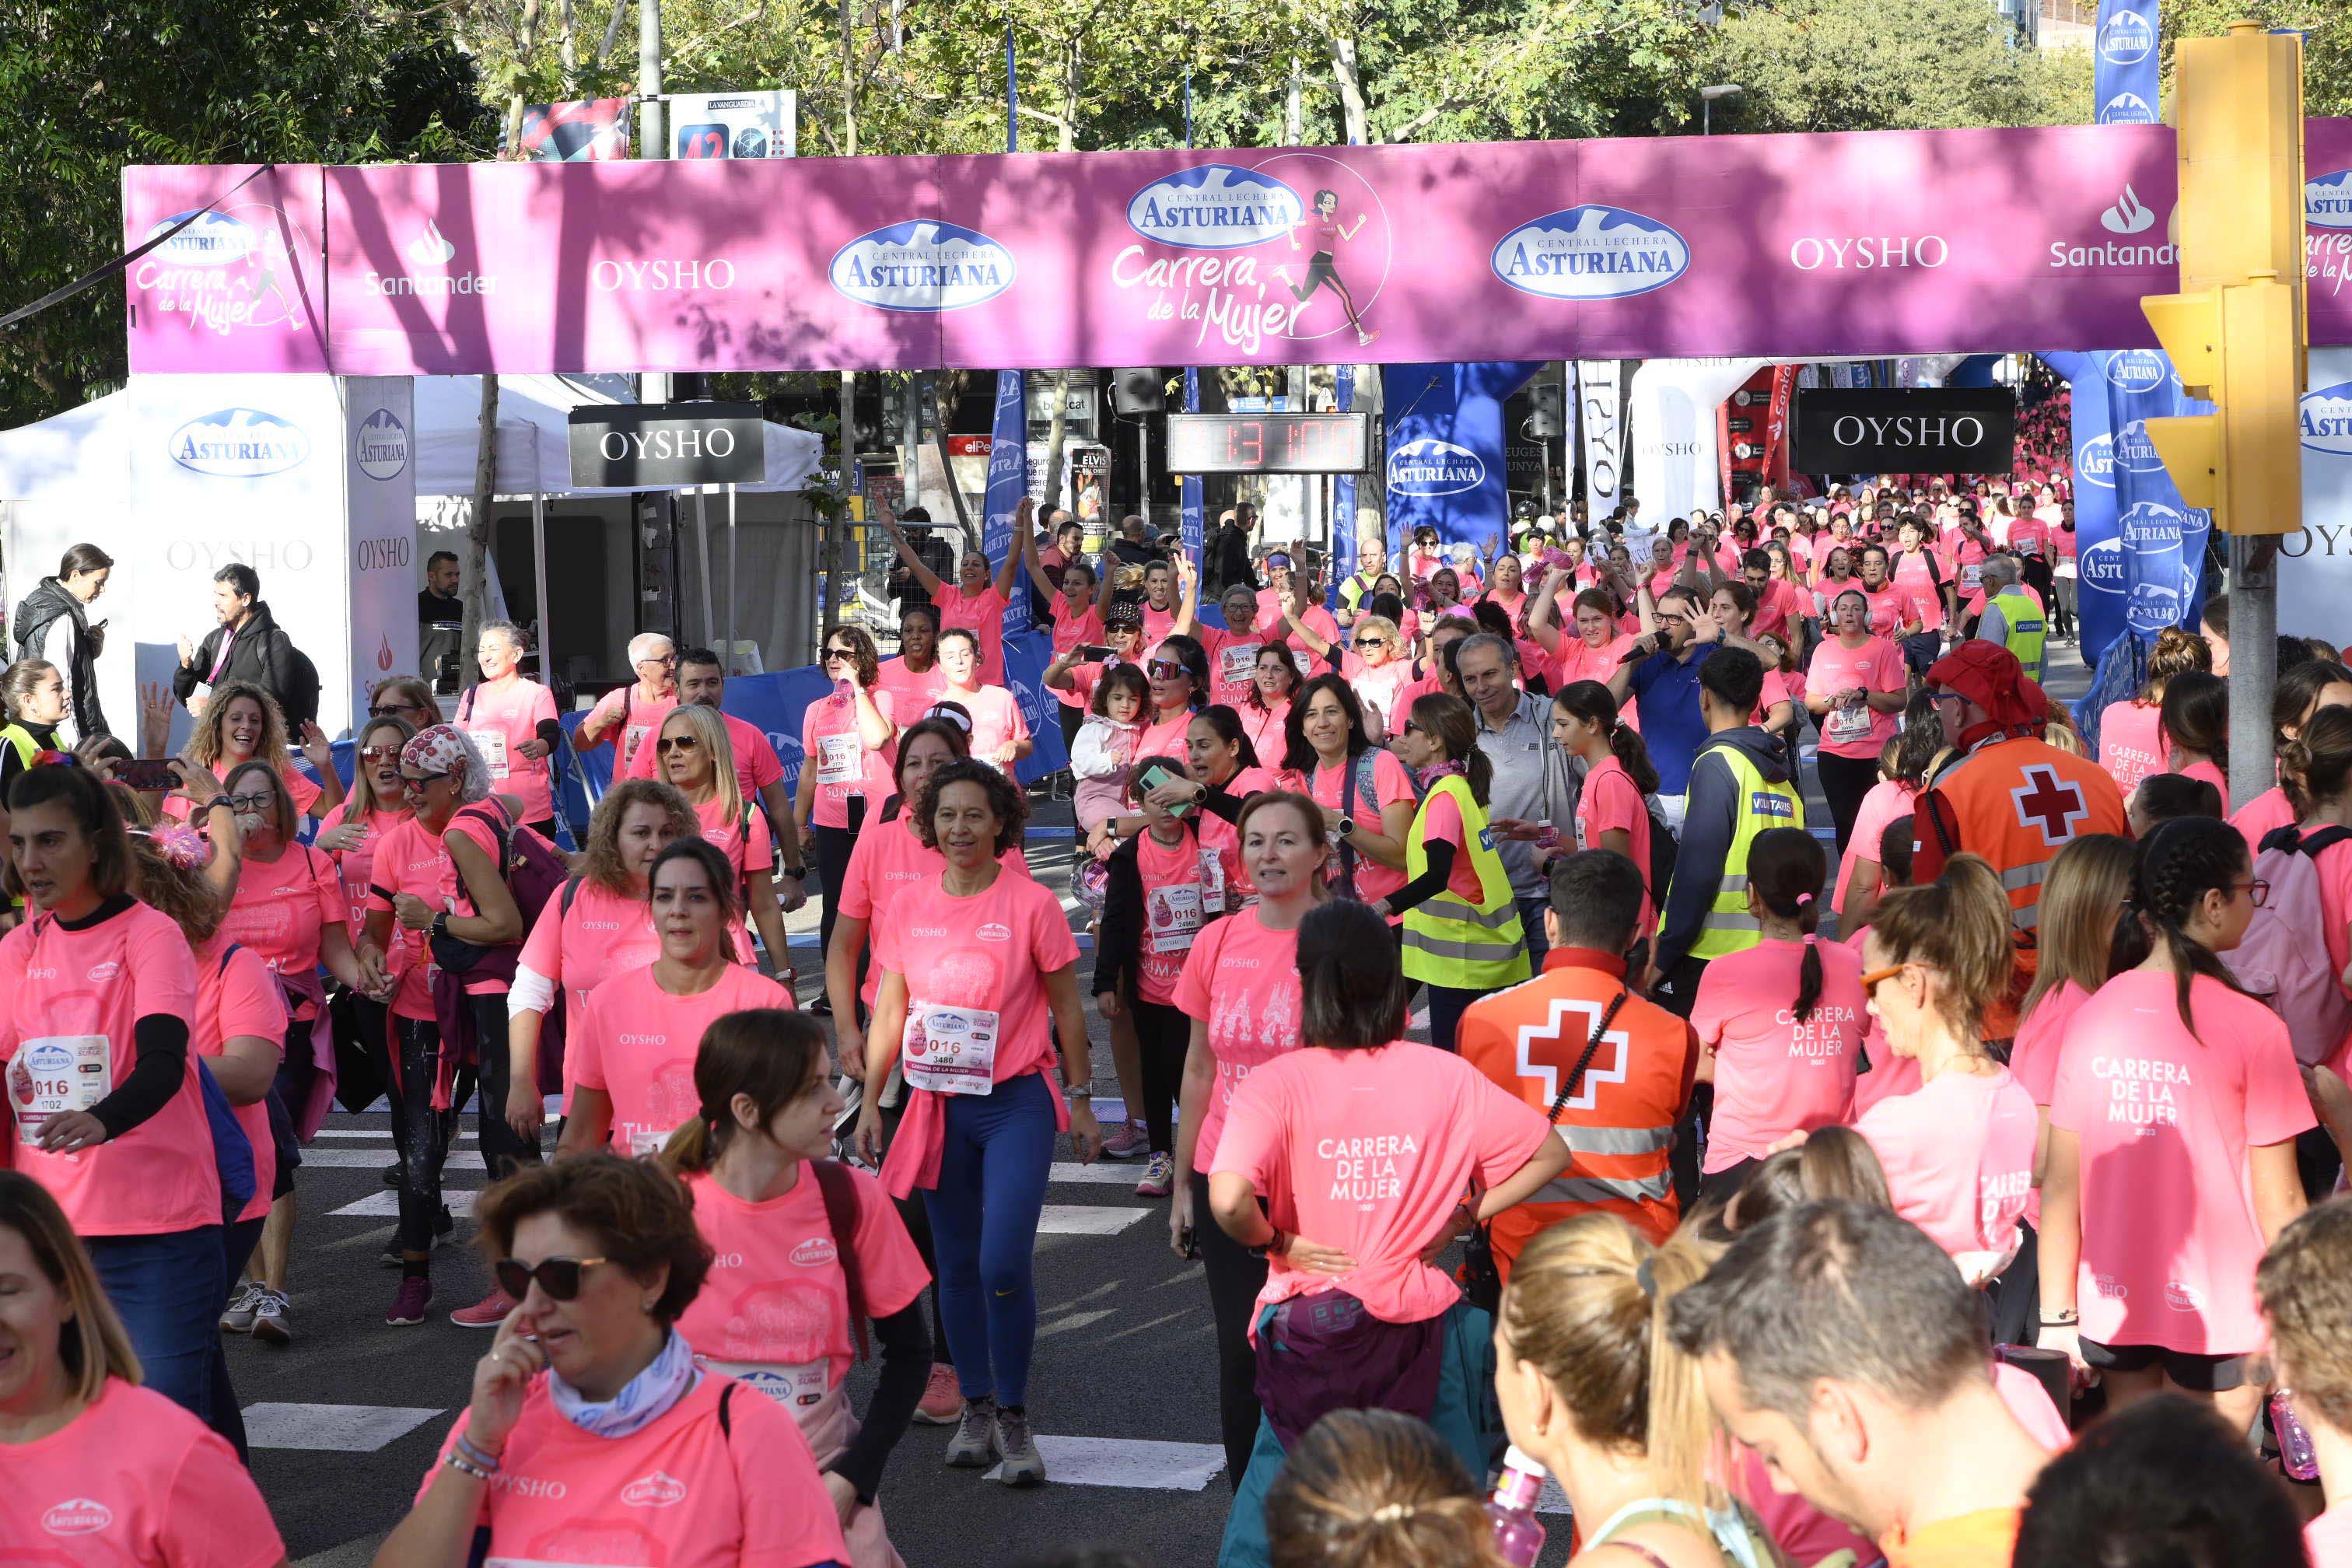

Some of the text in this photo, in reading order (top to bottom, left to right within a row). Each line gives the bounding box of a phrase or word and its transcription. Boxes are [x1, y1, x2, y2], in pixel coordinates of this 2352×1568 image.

[717, 100, 755, 108] VANGUARDIA
[1167, 192, 1284, 203] CENTRAL LECHERA
[1140, 197, 1290, 228] ASTURIANA
[1537, 235, 1668, 249] CENTRAL LECHERA
[1790, 235, 1948, 270] OYSHO
[2305, 233, 2352, 256] arre
[872, 250, 995, 261] CENTRAL LECHERA
[1111, 245, 1257, 289] Carrera
[1505, 242, 1675, 276] ASTURIANA
[2322, 256, 2336, 278] la
[136, 261, 227, 290] Carrera
[592, 260, 735, 292] OYSHO
[844, 254, 1002, 288] ASTURIANA
[364, 270, 499, 296] Santander
[158, 290, 191, 311] de la
[189, 289, 262, 335] Mujer
[1146, 289, 1200, 320] de la
[1195, 282, 1313, 355] Mujer
[1832, 415, 1984, 448] OYSHO
[179, 433, 300, 460] ASTURIANA
[359, 435, 405, 463] ASTURIANA
[600, 427, 735, 461] OYSHO
[1082, 456, 1106, 465] ELVIS
[1390, 463, 1478, 484] ASTURIANA
[2278, 523, 2352, 558] OY
[166, 538, 313, 572] OYSHO
[357, 537, 410, 572] OYSHO
[829, 752, 845, 761] 016
[2109, 744, 2157, 767] CARRERA
[2115, 758, 2145, 774] DE LA
[884, 871, 921, 880] OYSHO
[1174, 908, 1196, 919] 016
[582, 921, 620, 931] OYSHO
[912, 927, 947, 937] OYSHO
[1222, 957, 1260, 968] OYSHO
[933, 1019, 965, 1030] ASTURIANA
[1793, 1024, 1841, 1041] DE LA
[619, 1034, 666, 1045] OYSHO
[929, 1039, 961, 1054] 016
[1789, 1039, 1843, 1058] MUJER
[30, 1056, 70, 1066] ASTURIANA
[933, 1055, 954, 1064] 3480
[2091, 1056, 2191, 1086] CARRERA
[35, 1080, 69, 1096] 016
[2111, 1079, 2175, 1104] DE LA
[41, 1100, 61, 1110] 1702
[2107, 1101, 2178, 1125] MUJER
[2134, 1127, 2157, 1136] 2023
[1318, 1133, 1417, 1160] CARRERA
[1336, 1157, 1397, 1180] DE LA
[1331, 1178, 1401, 1202] MUJER
